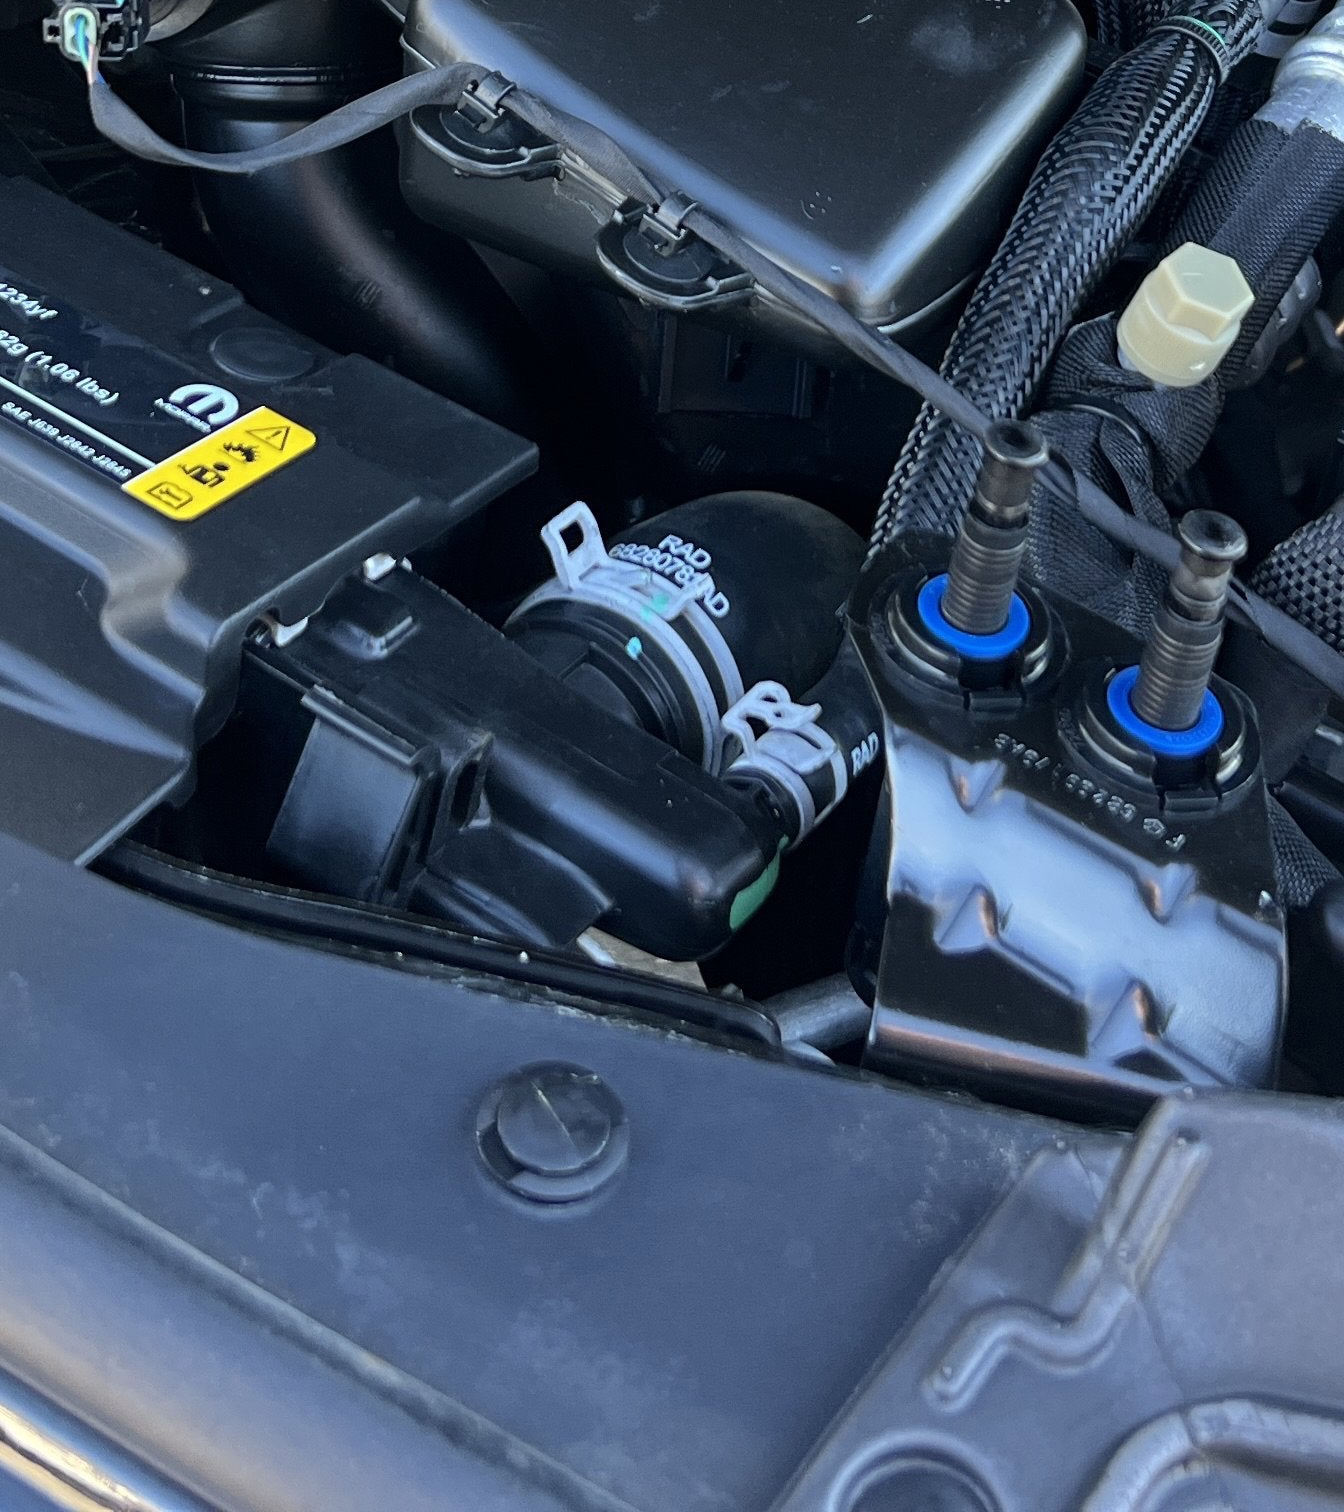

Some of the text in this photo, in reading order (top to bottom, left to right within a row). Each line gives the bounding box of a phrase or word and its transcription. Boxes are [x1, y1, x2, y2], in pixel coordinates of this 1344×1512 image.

[25, 350, 80, 382] (1.06
[76, 377, 119, 407] lbs)
[1, 401, 32, 422] SAE
[658, 534, 712, 570] RAD
[850, 731, 879, 777] RAD
